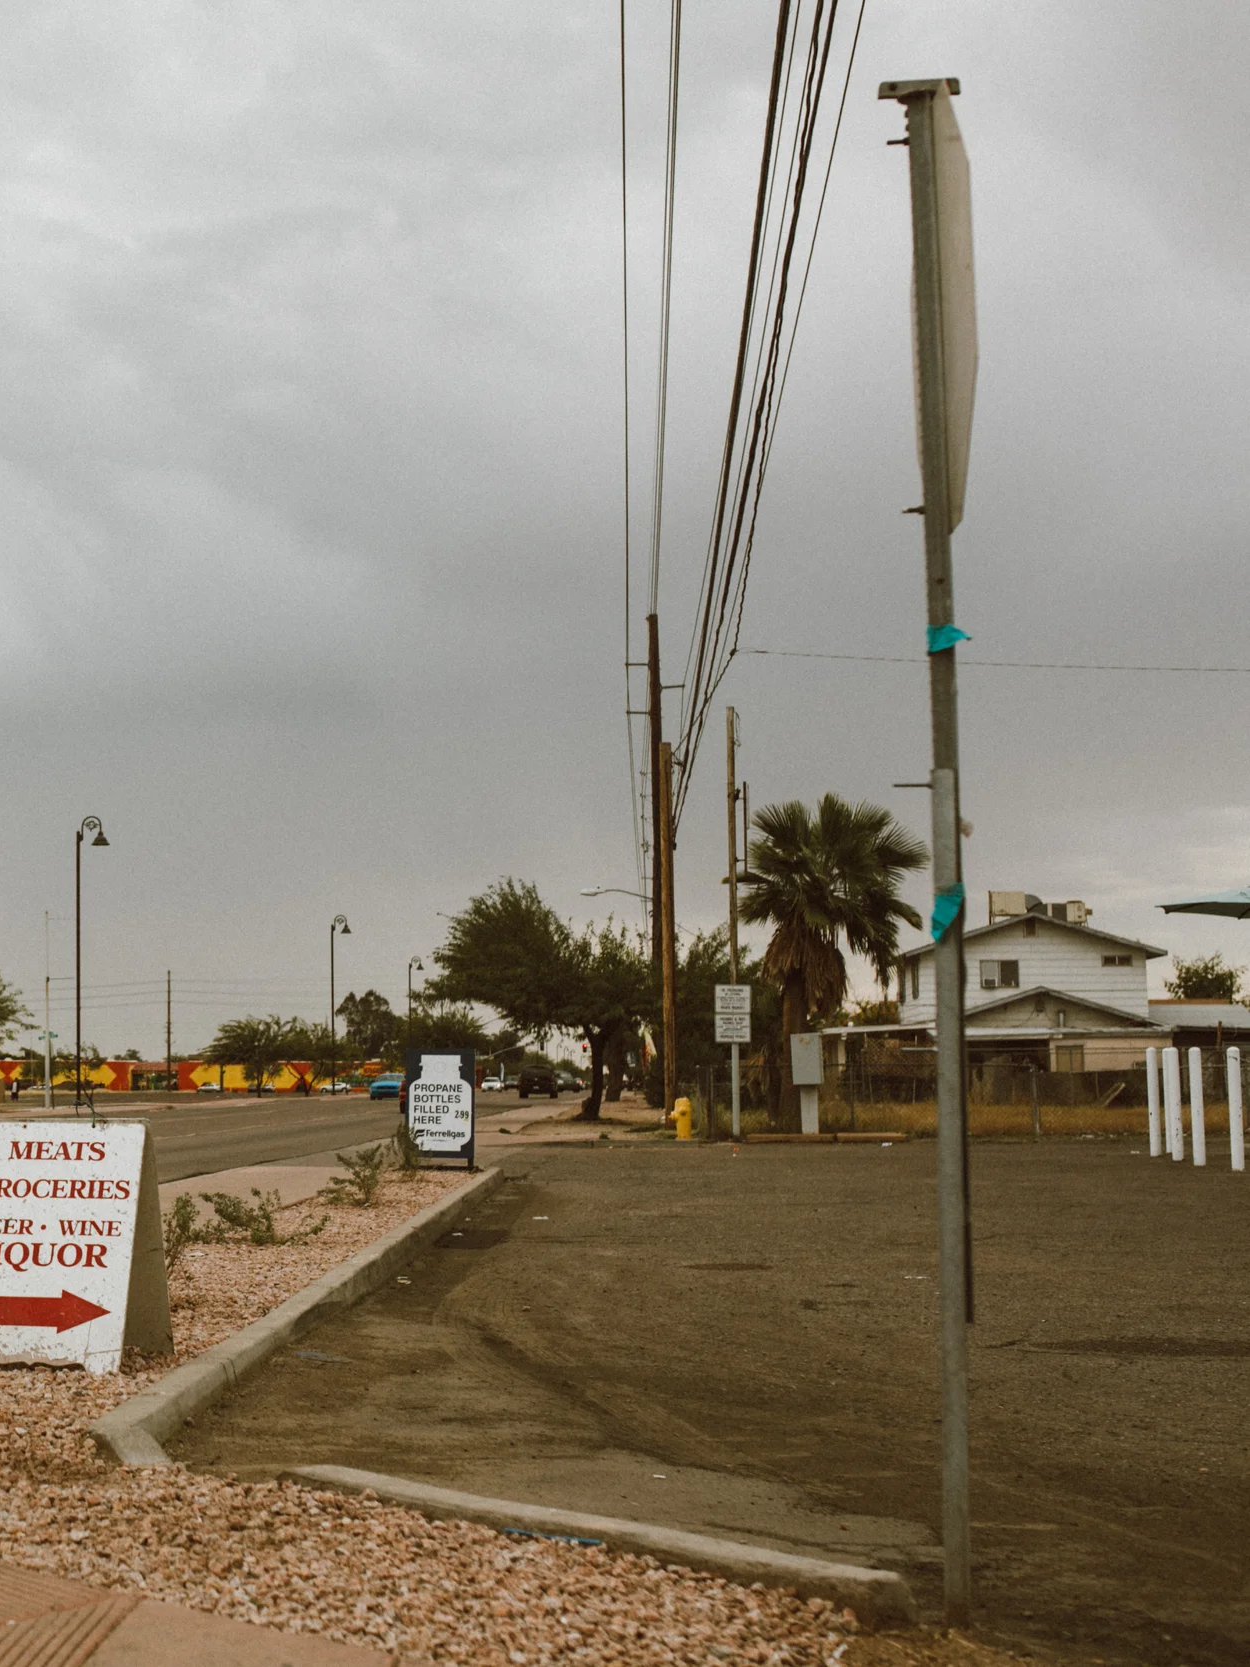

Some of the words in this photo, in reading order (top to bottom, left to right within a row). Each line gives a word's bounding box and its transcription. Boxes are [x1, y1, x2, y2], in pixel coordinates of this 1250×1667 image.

[414, 1084, 463, 1092] PROPANE
[414, 1095, 461, 1103] BOTTLES
[414, 1105, 450, 1114] FILLED
[413, 1116, 442, 1124] HERE
[426, 1130, 465, 1139] Ferrellgas
[8, 1141, 106, 1161] MEATS
[59, 1220, 122, 1237] WINE
